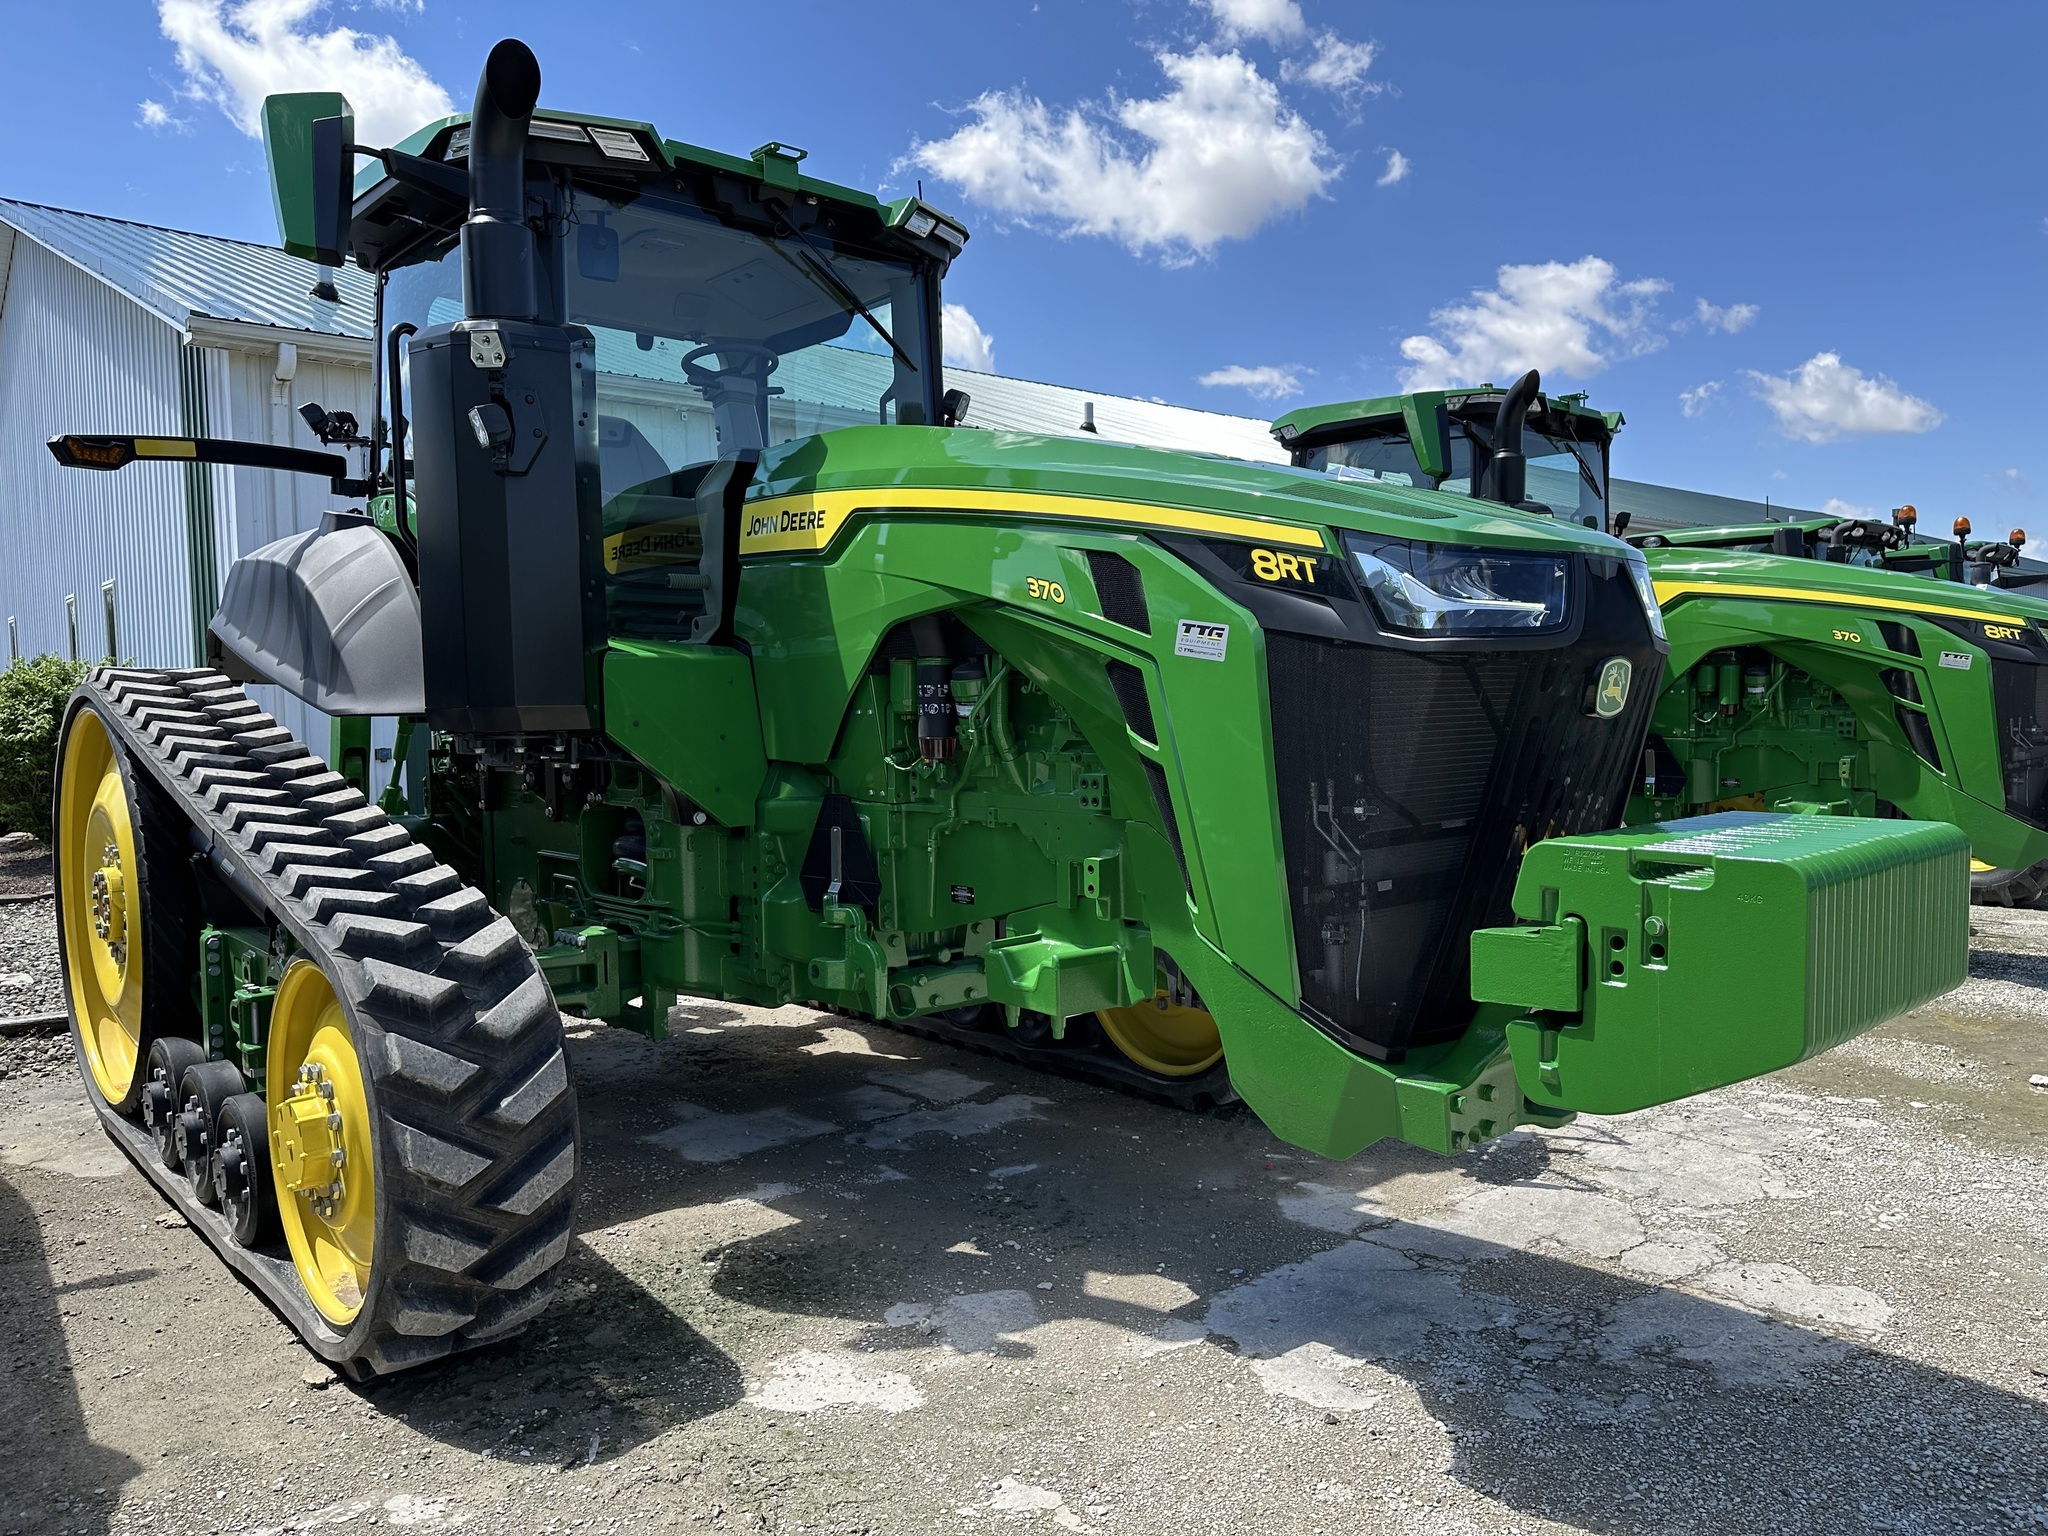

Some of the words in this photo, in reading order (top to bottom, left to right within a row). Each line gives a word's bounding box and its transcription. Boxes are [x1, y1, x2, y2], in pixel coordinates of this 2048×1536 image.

[746, 509, 778, 537] JOHN
[780, 509, 826, 532] DEERE
[1250, 548, 1318, 584] 8RT
[1026, 576, 1065, 604] 370
[1181, 622, 1226, 642] TTG
[1832, 629, 1862, 644] 370
[1983, 624, 2022, 641] 8RT
[1180, 637, 1220, 648] EQUIPMENT
